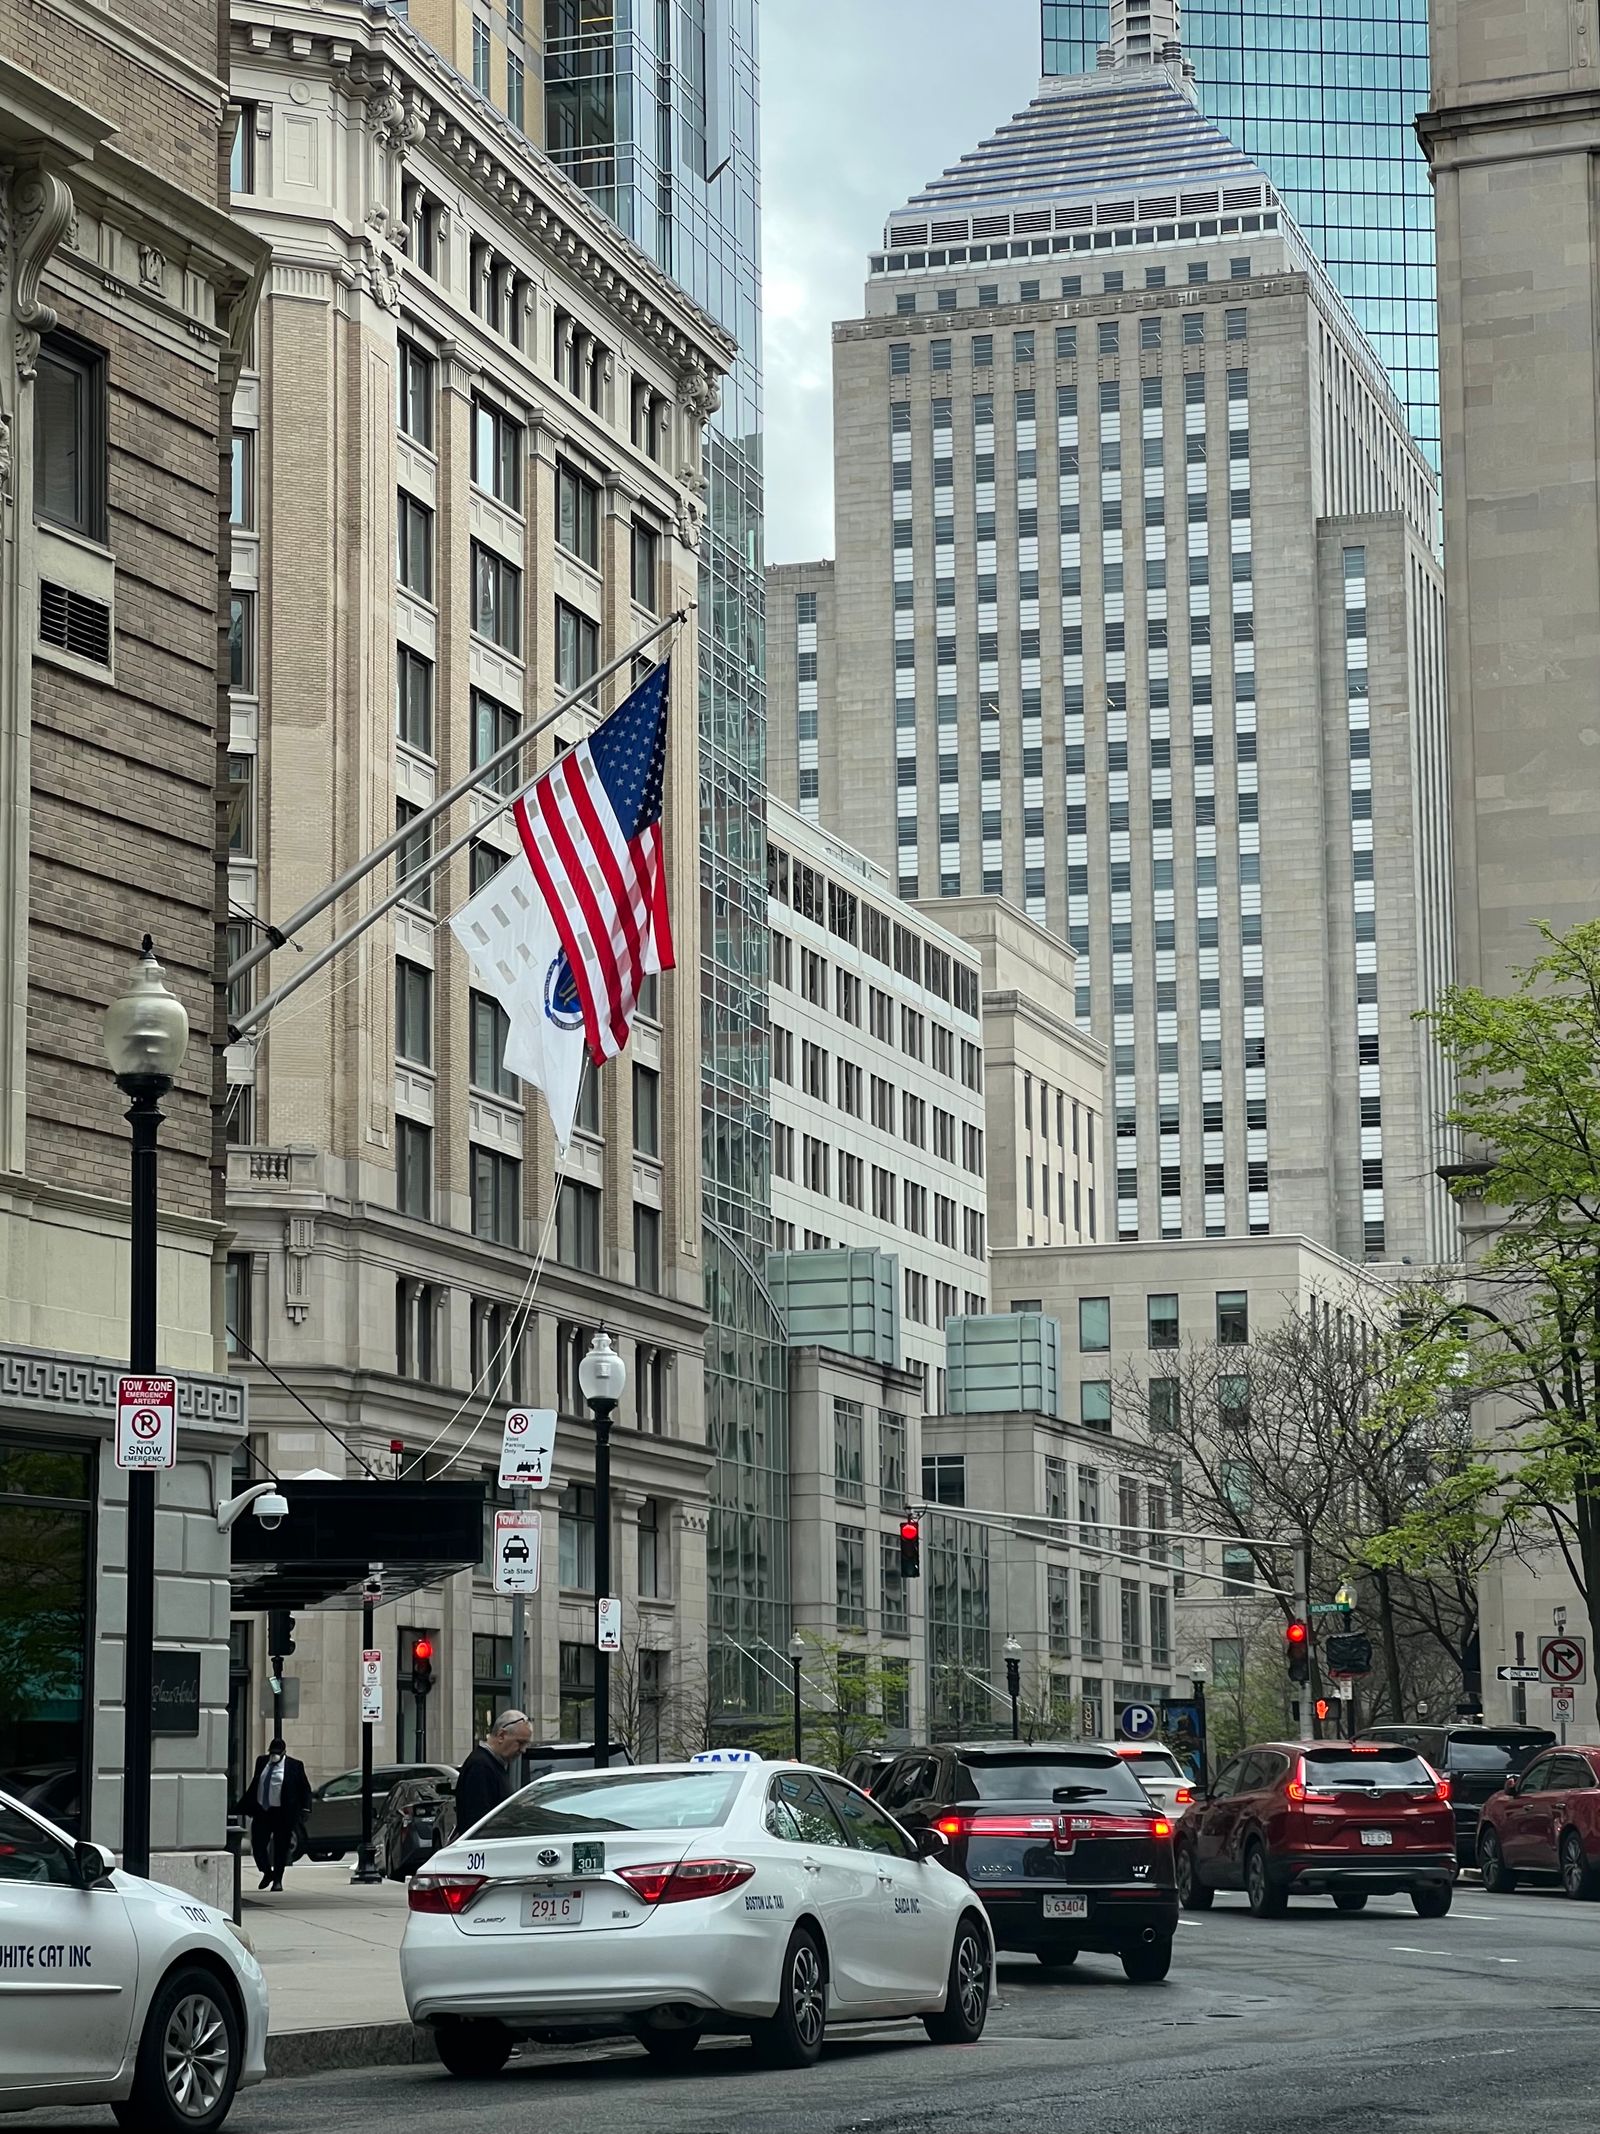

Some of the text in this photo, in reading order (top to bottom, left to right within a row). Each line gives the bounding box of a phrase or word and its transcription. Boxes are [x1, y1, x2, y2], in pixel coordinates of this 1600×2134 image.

[122, 1381, 173, 1392] TOW ZONE
[125, 1391, 168, 1399] EMERGENCY
[128, 1445, 162, 1455] SNOW
[499, 1515, 538, 1525] TOW ZONE
[1132, 1709, 1148, 1733] P
[467, 1852, 485, 1870] 301
[578, 1857, 598, 1870] 301
[532, 1899, 570, 1917] 291 G
[745, 1895, 765, 1910] BOSTON
[1054, 1900, 1085, 1913] 63404
[180, 1905, 212, 1925] 1701
[39, 1945, 65, 1968] CAT
[69, 1945, 92, 1968] INC
